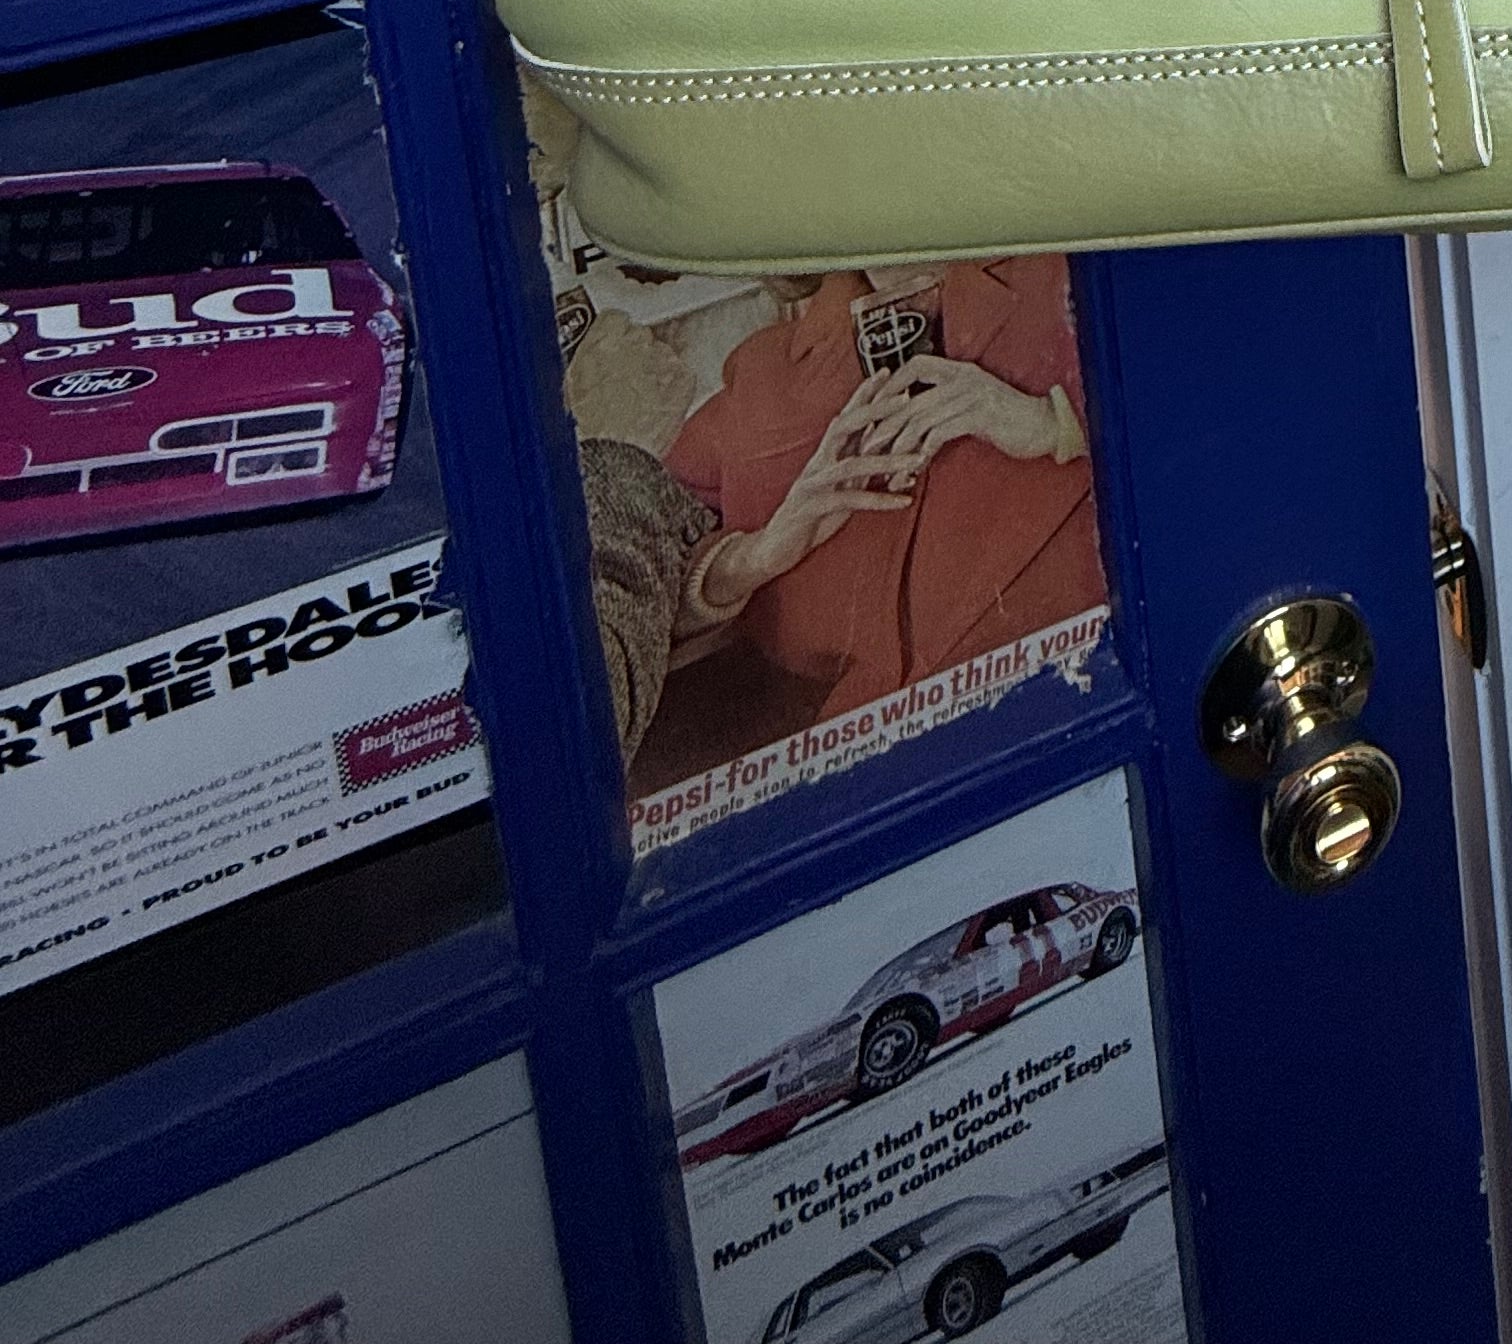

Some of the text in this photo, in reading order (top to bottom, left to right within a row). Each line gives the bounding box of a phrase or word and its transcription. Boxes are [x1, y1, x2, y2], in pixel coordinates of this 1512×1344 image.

[23, 321, 356, 363] OF BEERS
[862, 317, 916, 351] Pepsi
[50, 370, 133, 398] Ford
[52, 670, 216, 750] THE
[359, 706, 461, 755] Budweiser
[390, 719, 458, 759] Racing
[785, 712, 875, 768] those
[880, 684, 944, 726] who
[949, 646, 1030, 696] think
[141, 860, 245, 912] PROUD
[250, 844, 288, 867] TO
[296, 827, 328, 849] BE
[335, 794, 409, 832] YOUR
[416, 771, 471, 800] BUD
[712, 1037, 1133, 1271] Monte Carlos are on Goodyear Eagles
[772, 1042, 1078, 1211] The fact that both of those
[839, 1120, 1034, 1229] is no coincidence.
